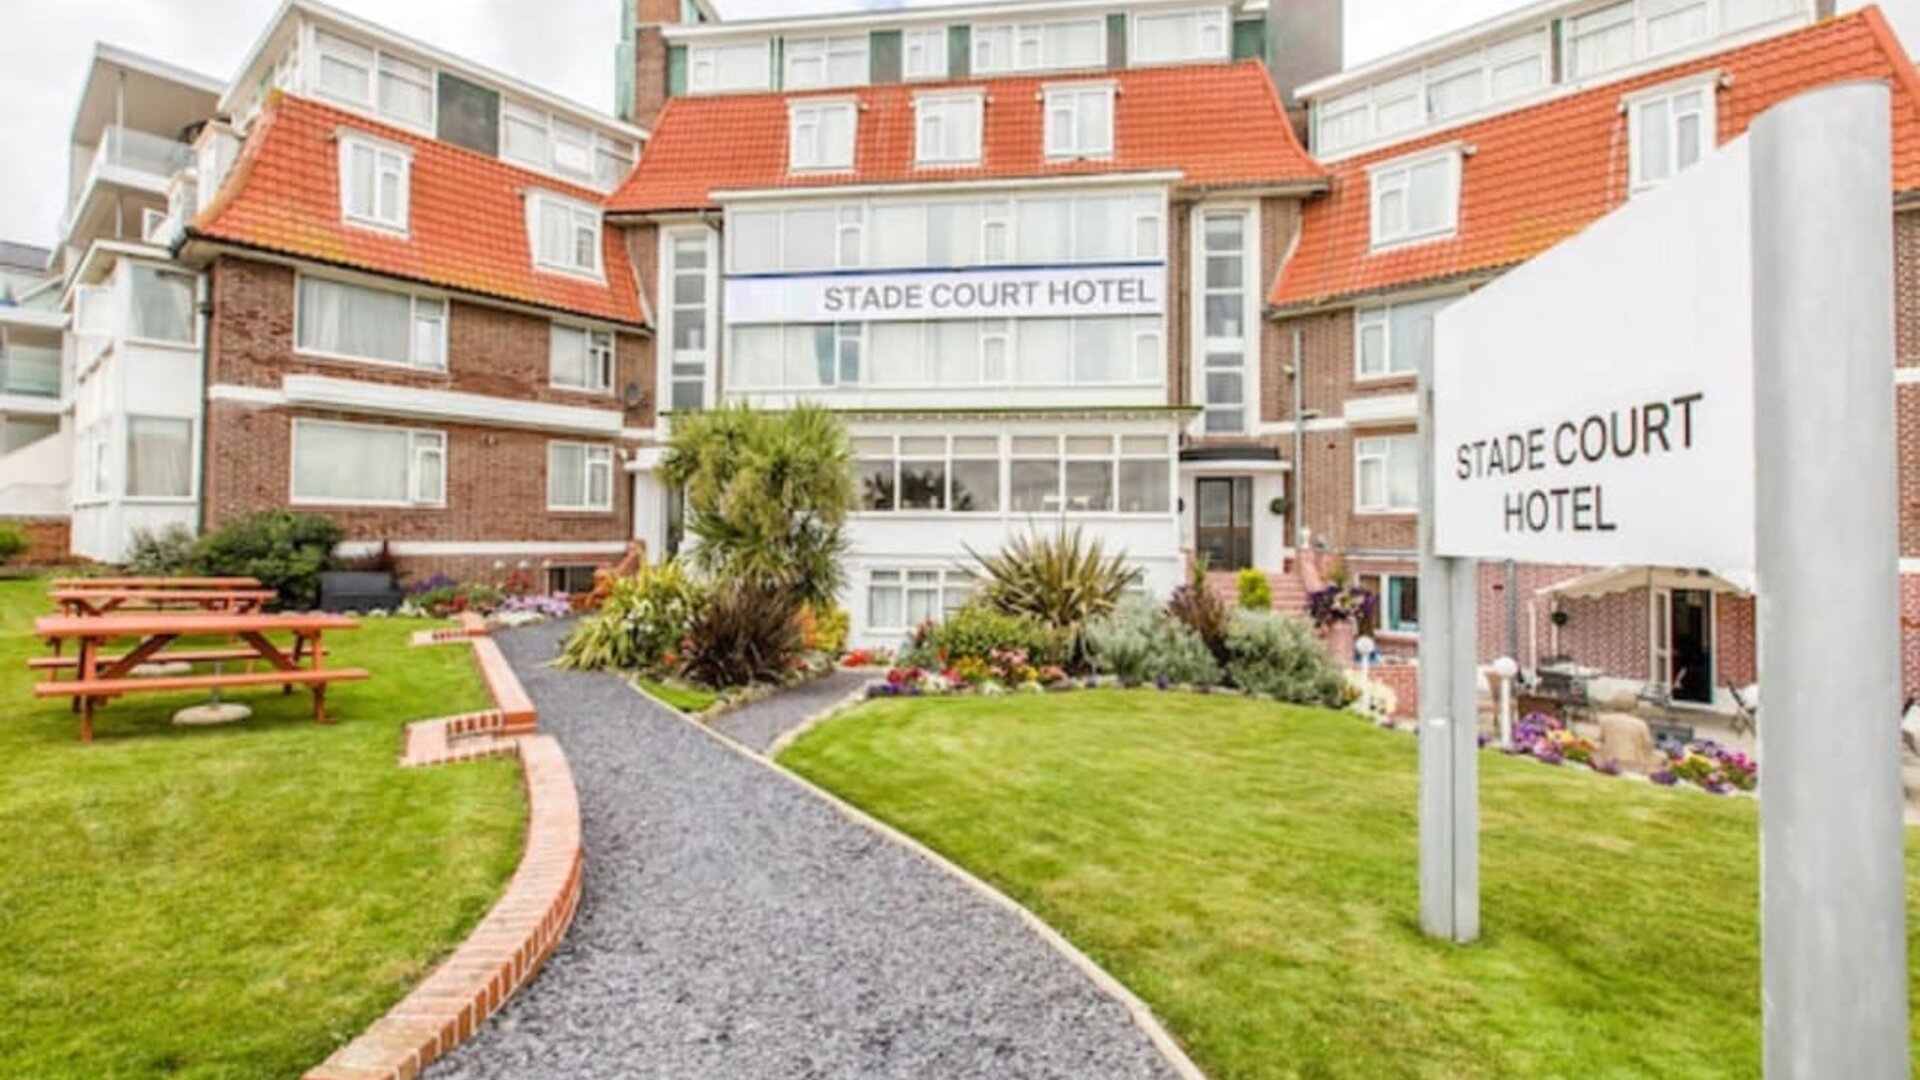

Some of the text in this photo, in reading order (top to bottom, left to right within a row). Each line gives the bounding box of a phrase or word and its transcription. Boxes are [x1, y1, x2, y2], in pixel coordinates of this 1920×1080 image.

[824, 277, 1155, 312] STADE COURT HOTEL
[1457, 392, 1704, 480] STADE COURT
[1504, 485, 1617, 532] HOTEL
